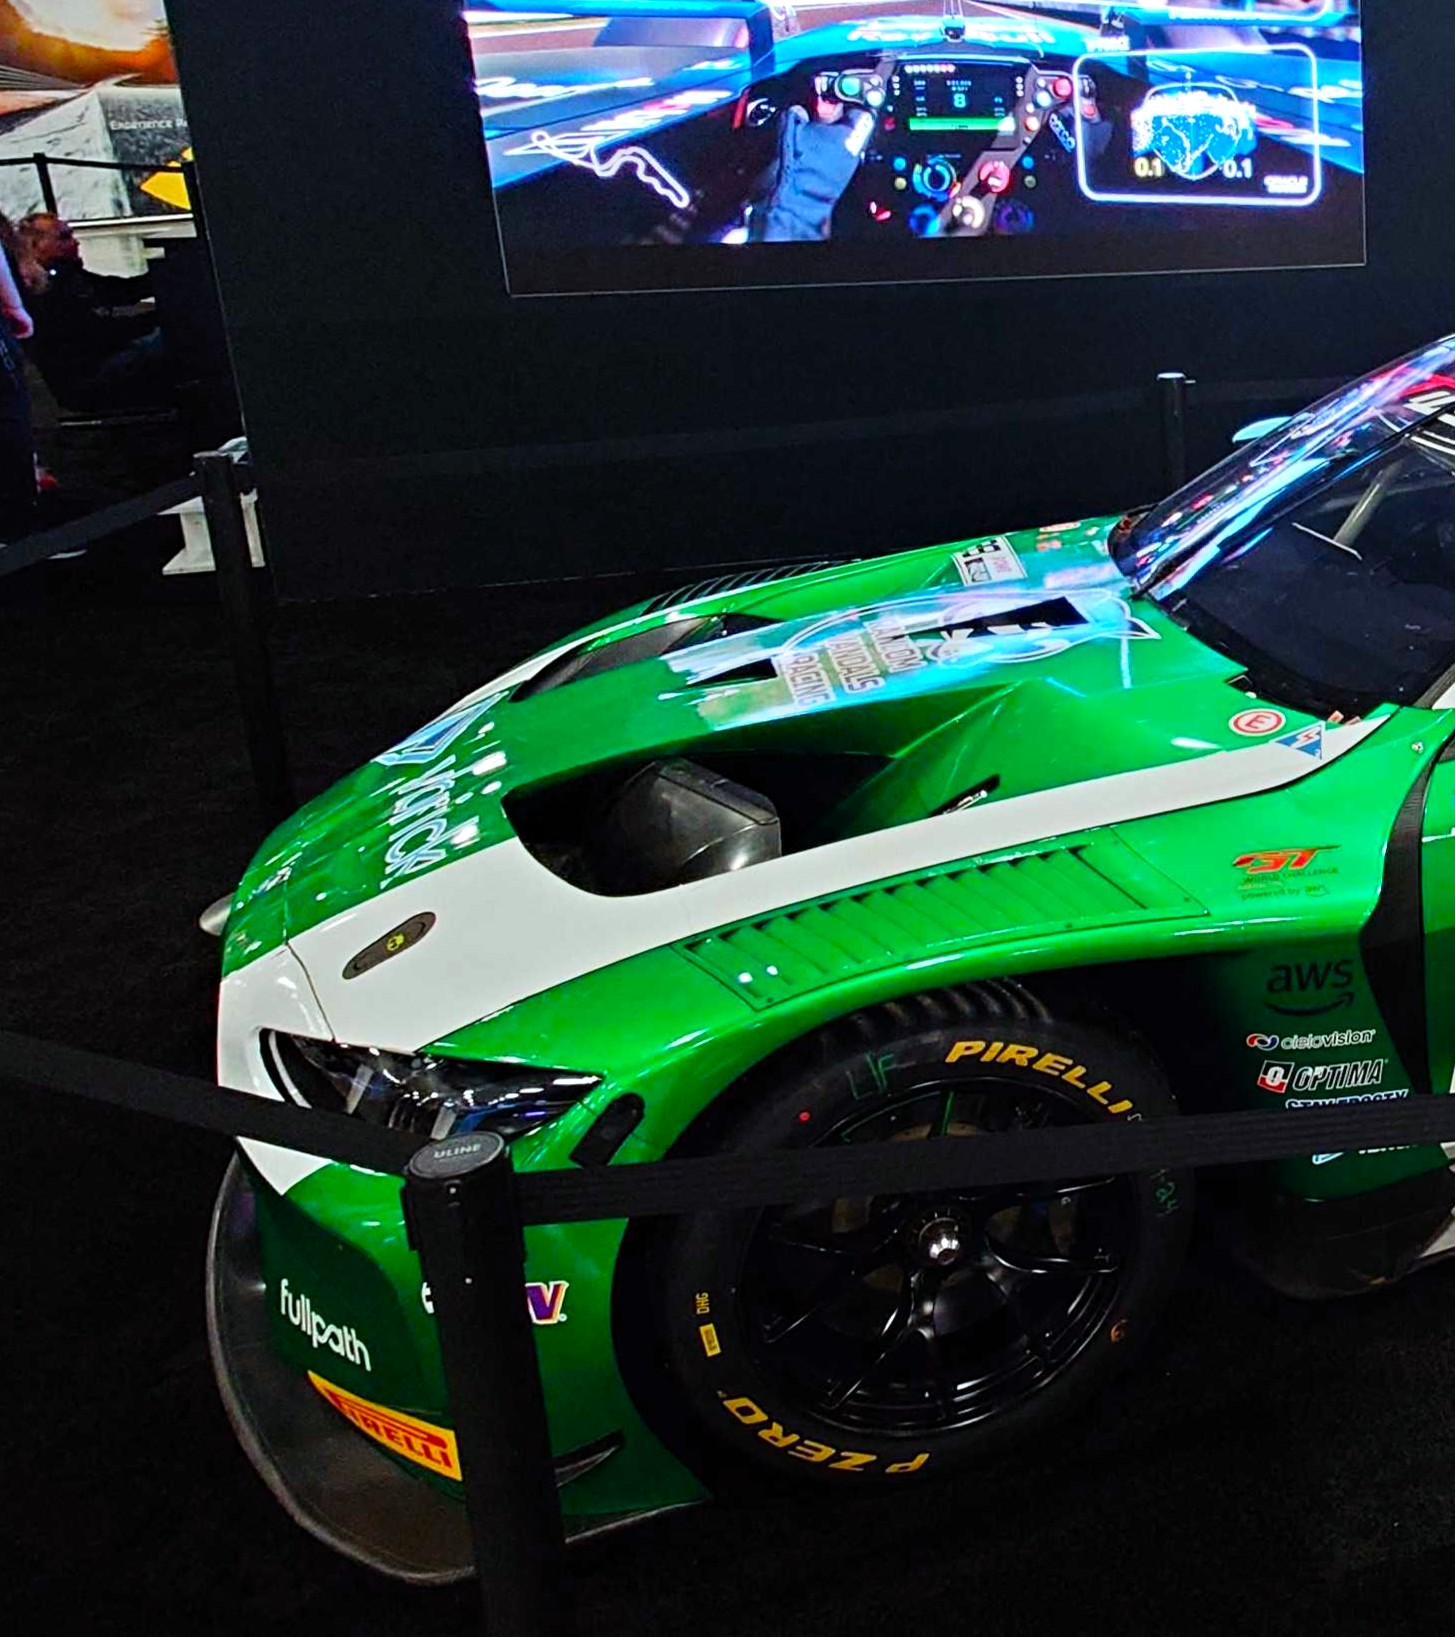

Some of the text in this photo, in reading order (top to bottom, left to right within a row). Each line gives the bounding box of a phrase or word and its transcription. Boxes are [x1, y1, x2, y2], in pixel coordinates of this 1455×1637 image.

[1134, 157, 1164, 177] 0.1
[1222, 158, 1252, 178] 0.1
[1265, 958, 1355, 994] aws
[945, 1040, 1133, 1114] PIRELLI
[1291, 1058, 1384, 1092] OPTIMA
[433, 1142, 481, 1159] ULINE
[280, 1278, 372, 1372] fullpath
[323, 1387, 454, 1469] PIRELLI
[722, 1397, 930, 1473] P ZERO
